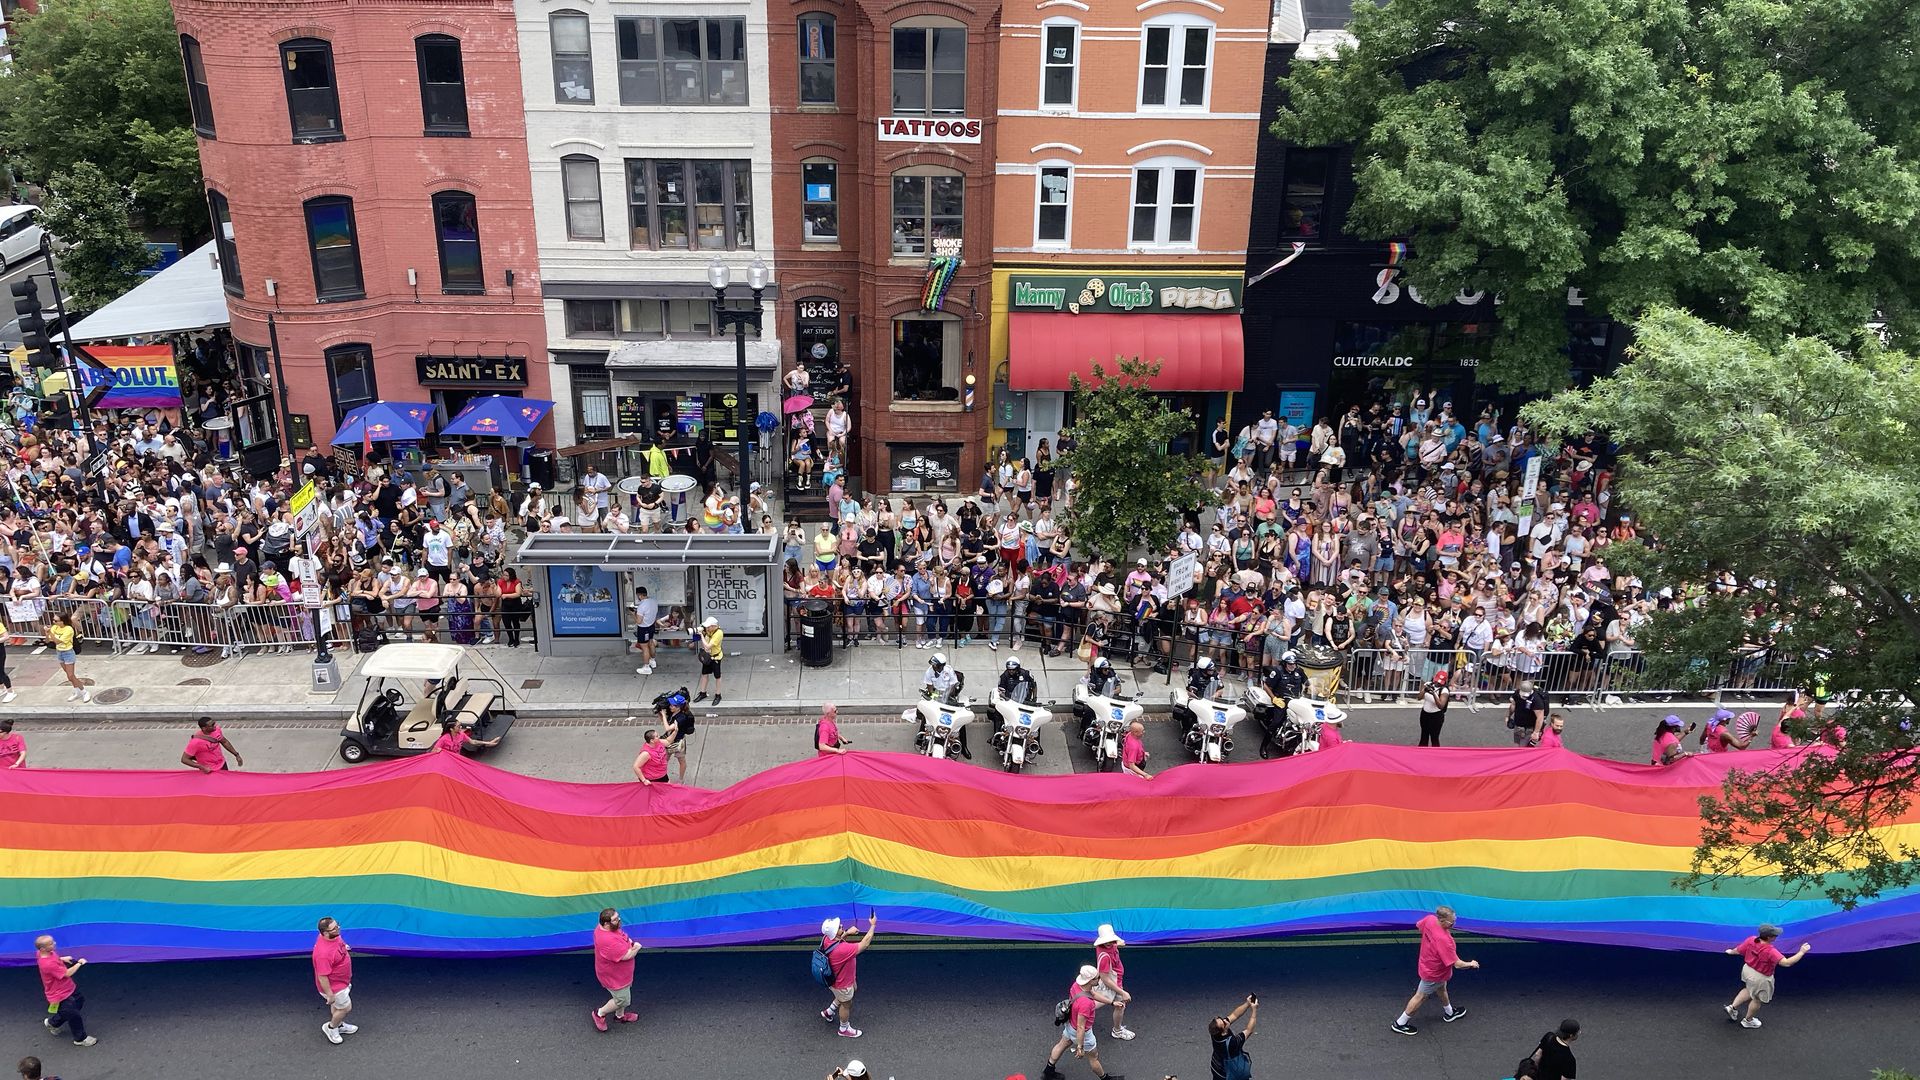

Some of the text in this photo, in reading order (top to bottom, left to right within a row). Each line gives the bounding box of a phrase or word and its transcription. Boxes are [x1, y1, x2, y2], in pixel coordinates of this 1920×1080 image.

[810, 26, 819, 58] OPEN
[881, 119, 981, 138] TATTOOS
[933, 238, 963, 248] SMOKE
[936, 247, 960, 256] SHOP
[1015, 281, 1236, 310] Manny & Olga's PIZZA
[800, 302, 838, 318] 1843
[1333, 356, 1414, 368] CULTURALDC
[1459, 358, 1480, 368] 1835
[78, 366, 174, 387] ABSOLUT.
[333, 447, 355, 464] JESUS
[705, 568, 732, 579] THE
[1176, 566, 1189, 576] FROM
[707, 579, 749, 590] PAPER
[1174, 582, 1186, 592] ONLY
[707, 589, 757, 600] CEILING
[705, 600, 738, 610] .ORG
